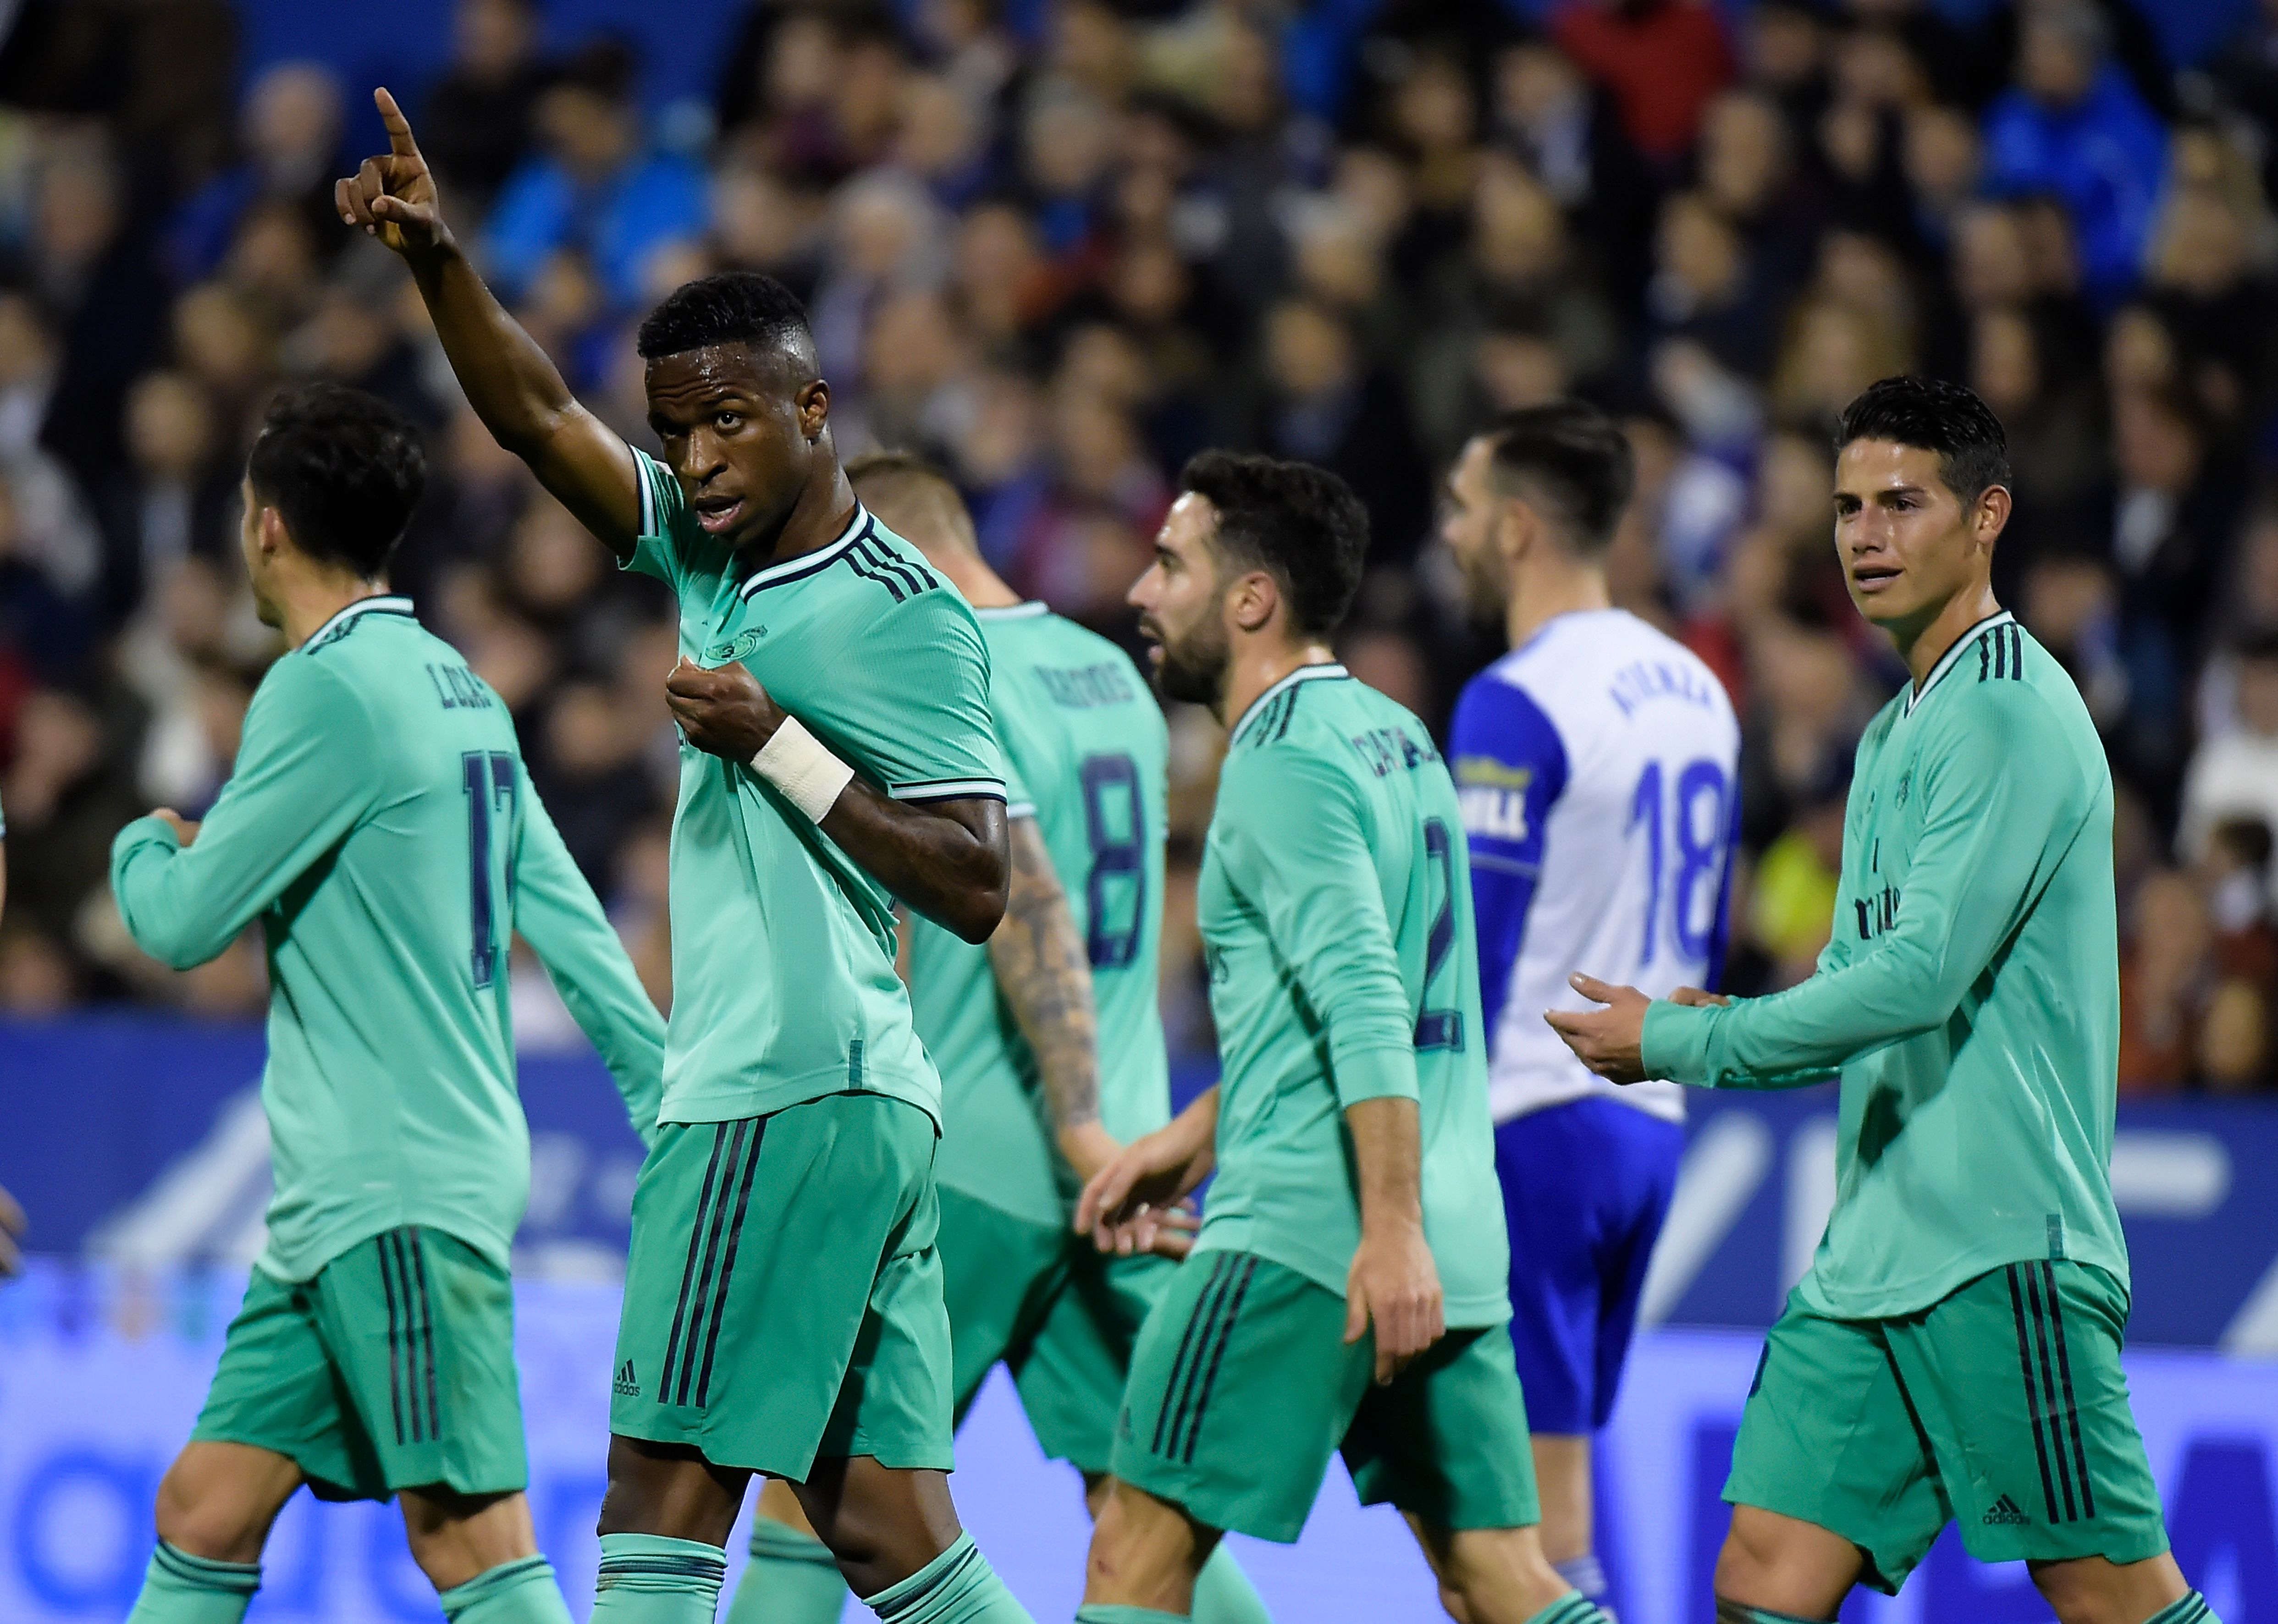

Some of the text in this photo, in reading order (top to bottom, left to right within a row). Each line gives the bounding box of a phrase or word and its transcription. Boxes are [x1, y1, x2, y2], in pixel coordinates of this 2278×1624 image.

[461, 750, 515, 989] 17
[1078, 753, 1146, 970] 8
[1414, 816, 1465, 1053] 2
[1625, 757, 1726, 967] 18
